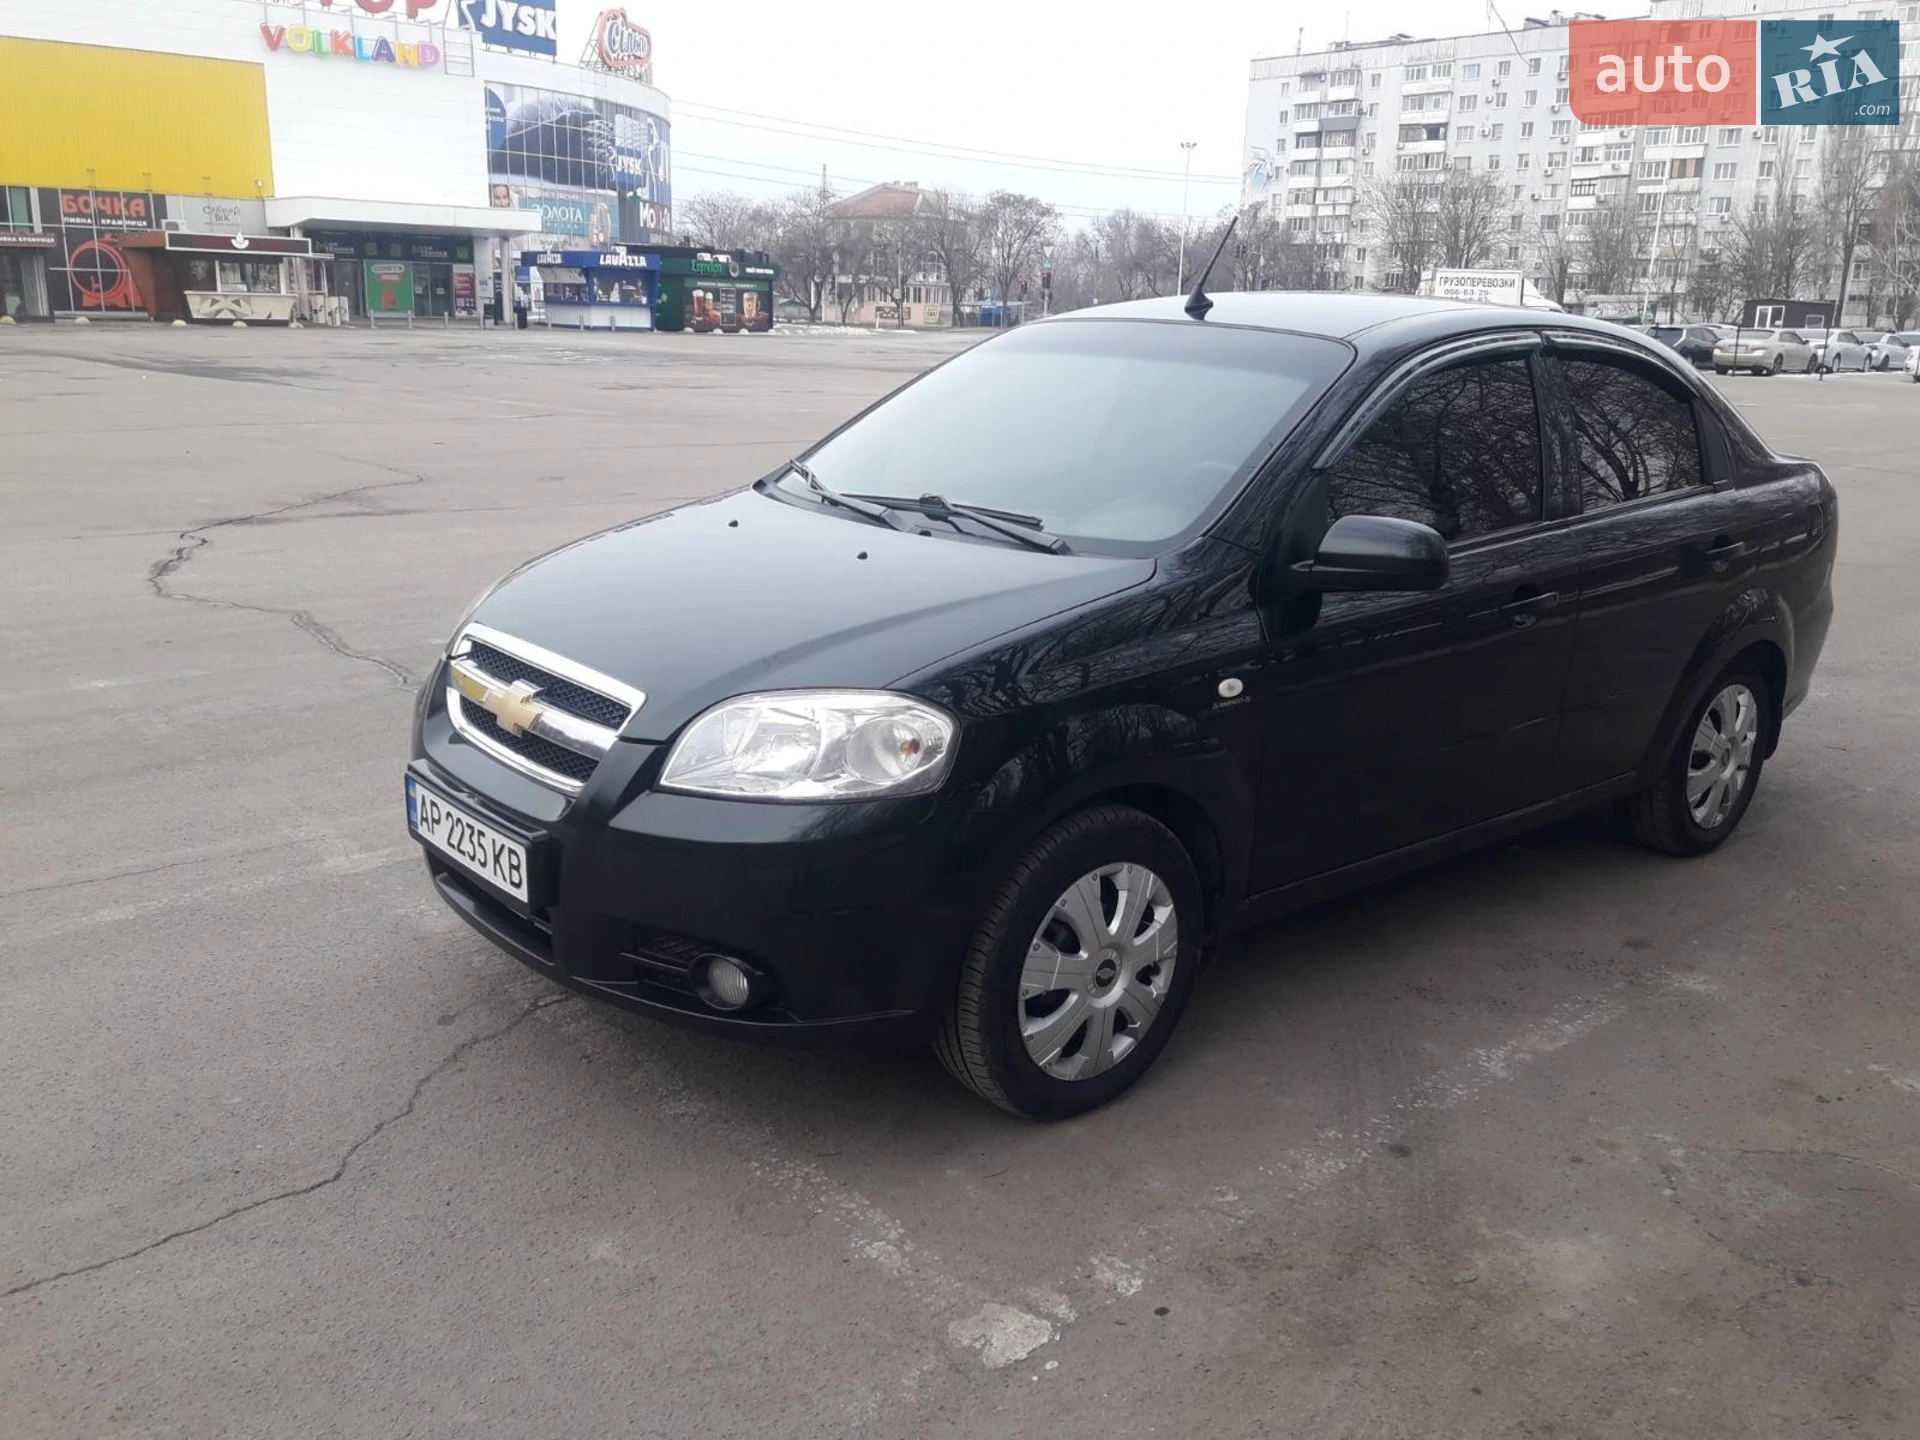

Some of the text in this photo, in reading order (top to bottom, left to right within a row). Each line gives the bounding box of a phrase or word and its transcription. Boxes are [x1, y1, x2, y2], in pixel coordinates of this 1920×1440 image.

[480, 0, 557, 40] JYSK
[260, 23, 440, 68] VOLKLAND
[617, 157, 643, 174] JYSK
[62, 193, 146, 217] БОЧКА
[600, 252, 647, 267] LAVAZZA
[1439, 276, 1516, 288] ГРУЗОПЕРЕВОЗКИ
[420, 793, 523, 890] AP 2235 KB
